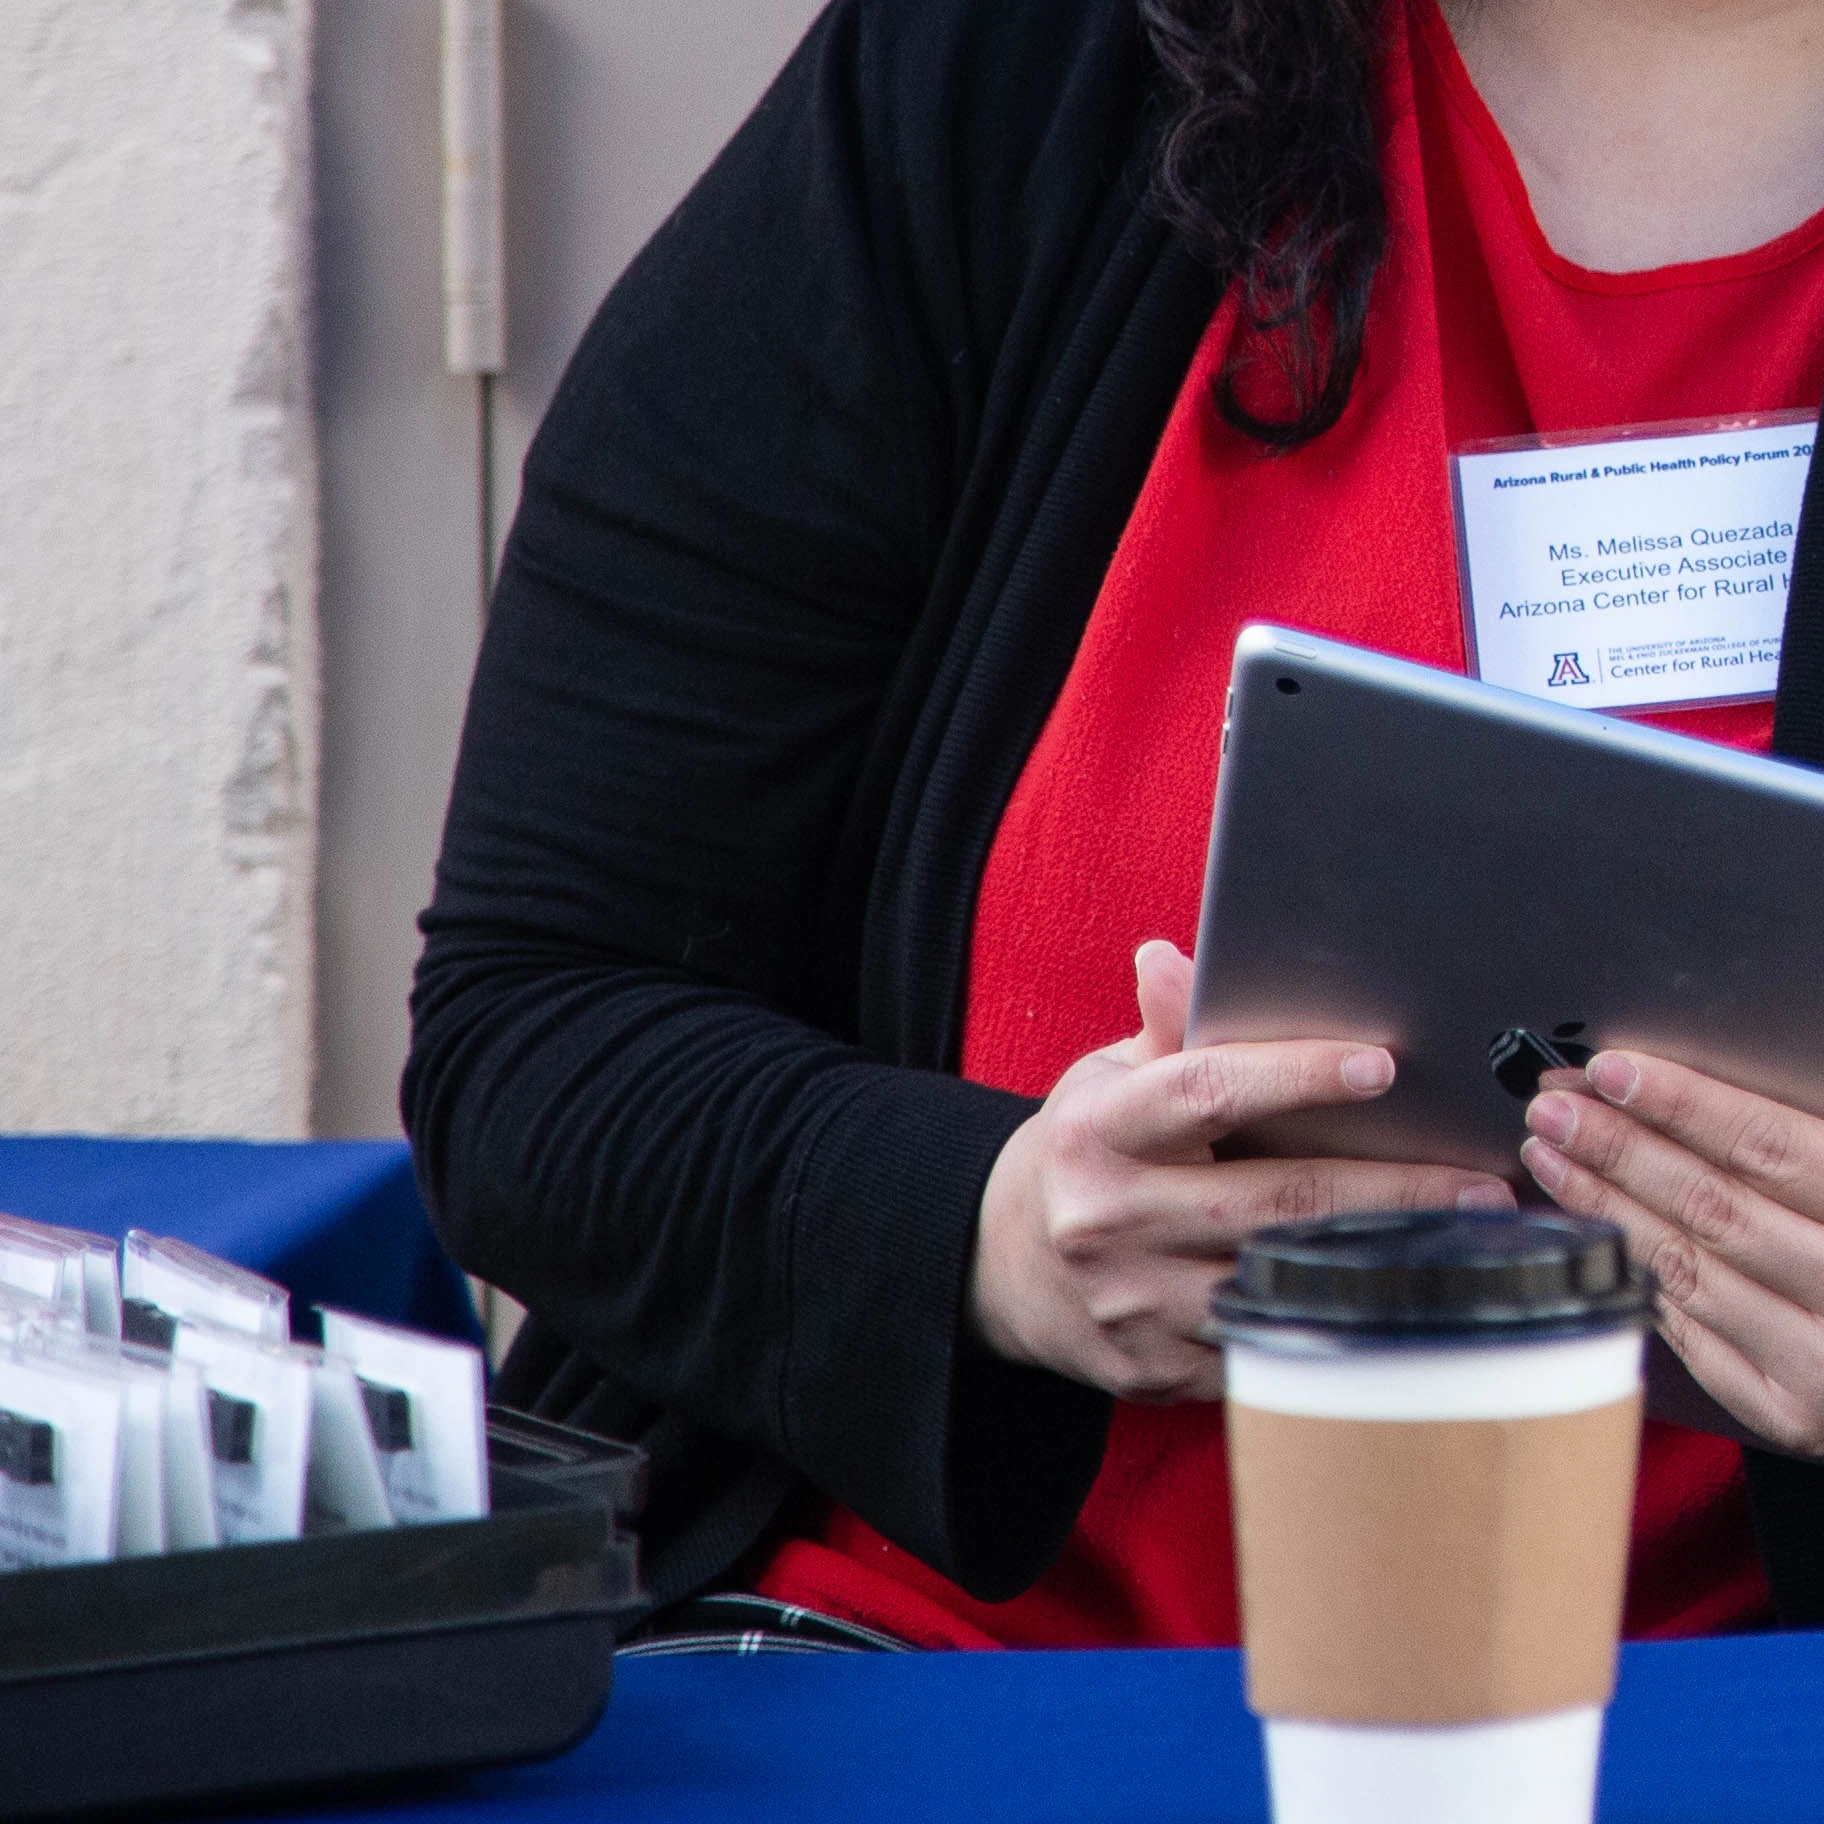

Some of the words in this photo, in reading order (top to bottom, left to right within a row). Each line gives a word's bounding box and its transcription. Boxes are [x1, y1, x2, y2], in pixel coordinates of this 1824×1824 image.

[1493, 475, 1546, 489] Arizona
[1550, 468, 1587, 483] Rural
[1590, 467, 1600, 479] &
[1604, 462, 1647, 477] Public
[1650, 457, 1696, 472] Health
[1700, 452, 1740, 467] Policy
[1744, 448, 1790, 463] Forum
[1793, 444, 1815, 458] 20
[1549, 543, 1590, 562] Ms.
[1597, 534, 1683, 557] Melissa
[1690, 520, 1794, 546] Quezada
[1561, 561, 1671, 587] Executive
[1678, 548, 1788, 575] Associate
[1499, 598, 1585, 620] Arizona
[1593, 589, 1670, 610] Center
[1677, 583, 1707, 601] for
[1714, 573, 1775, 597] Rural
[1547, 652, 1590, 688] A
[1610, 662, 1668, 679] Center
[1672, 657, 1697, 673] for
[1701, 651, 1745, 670] Rural
